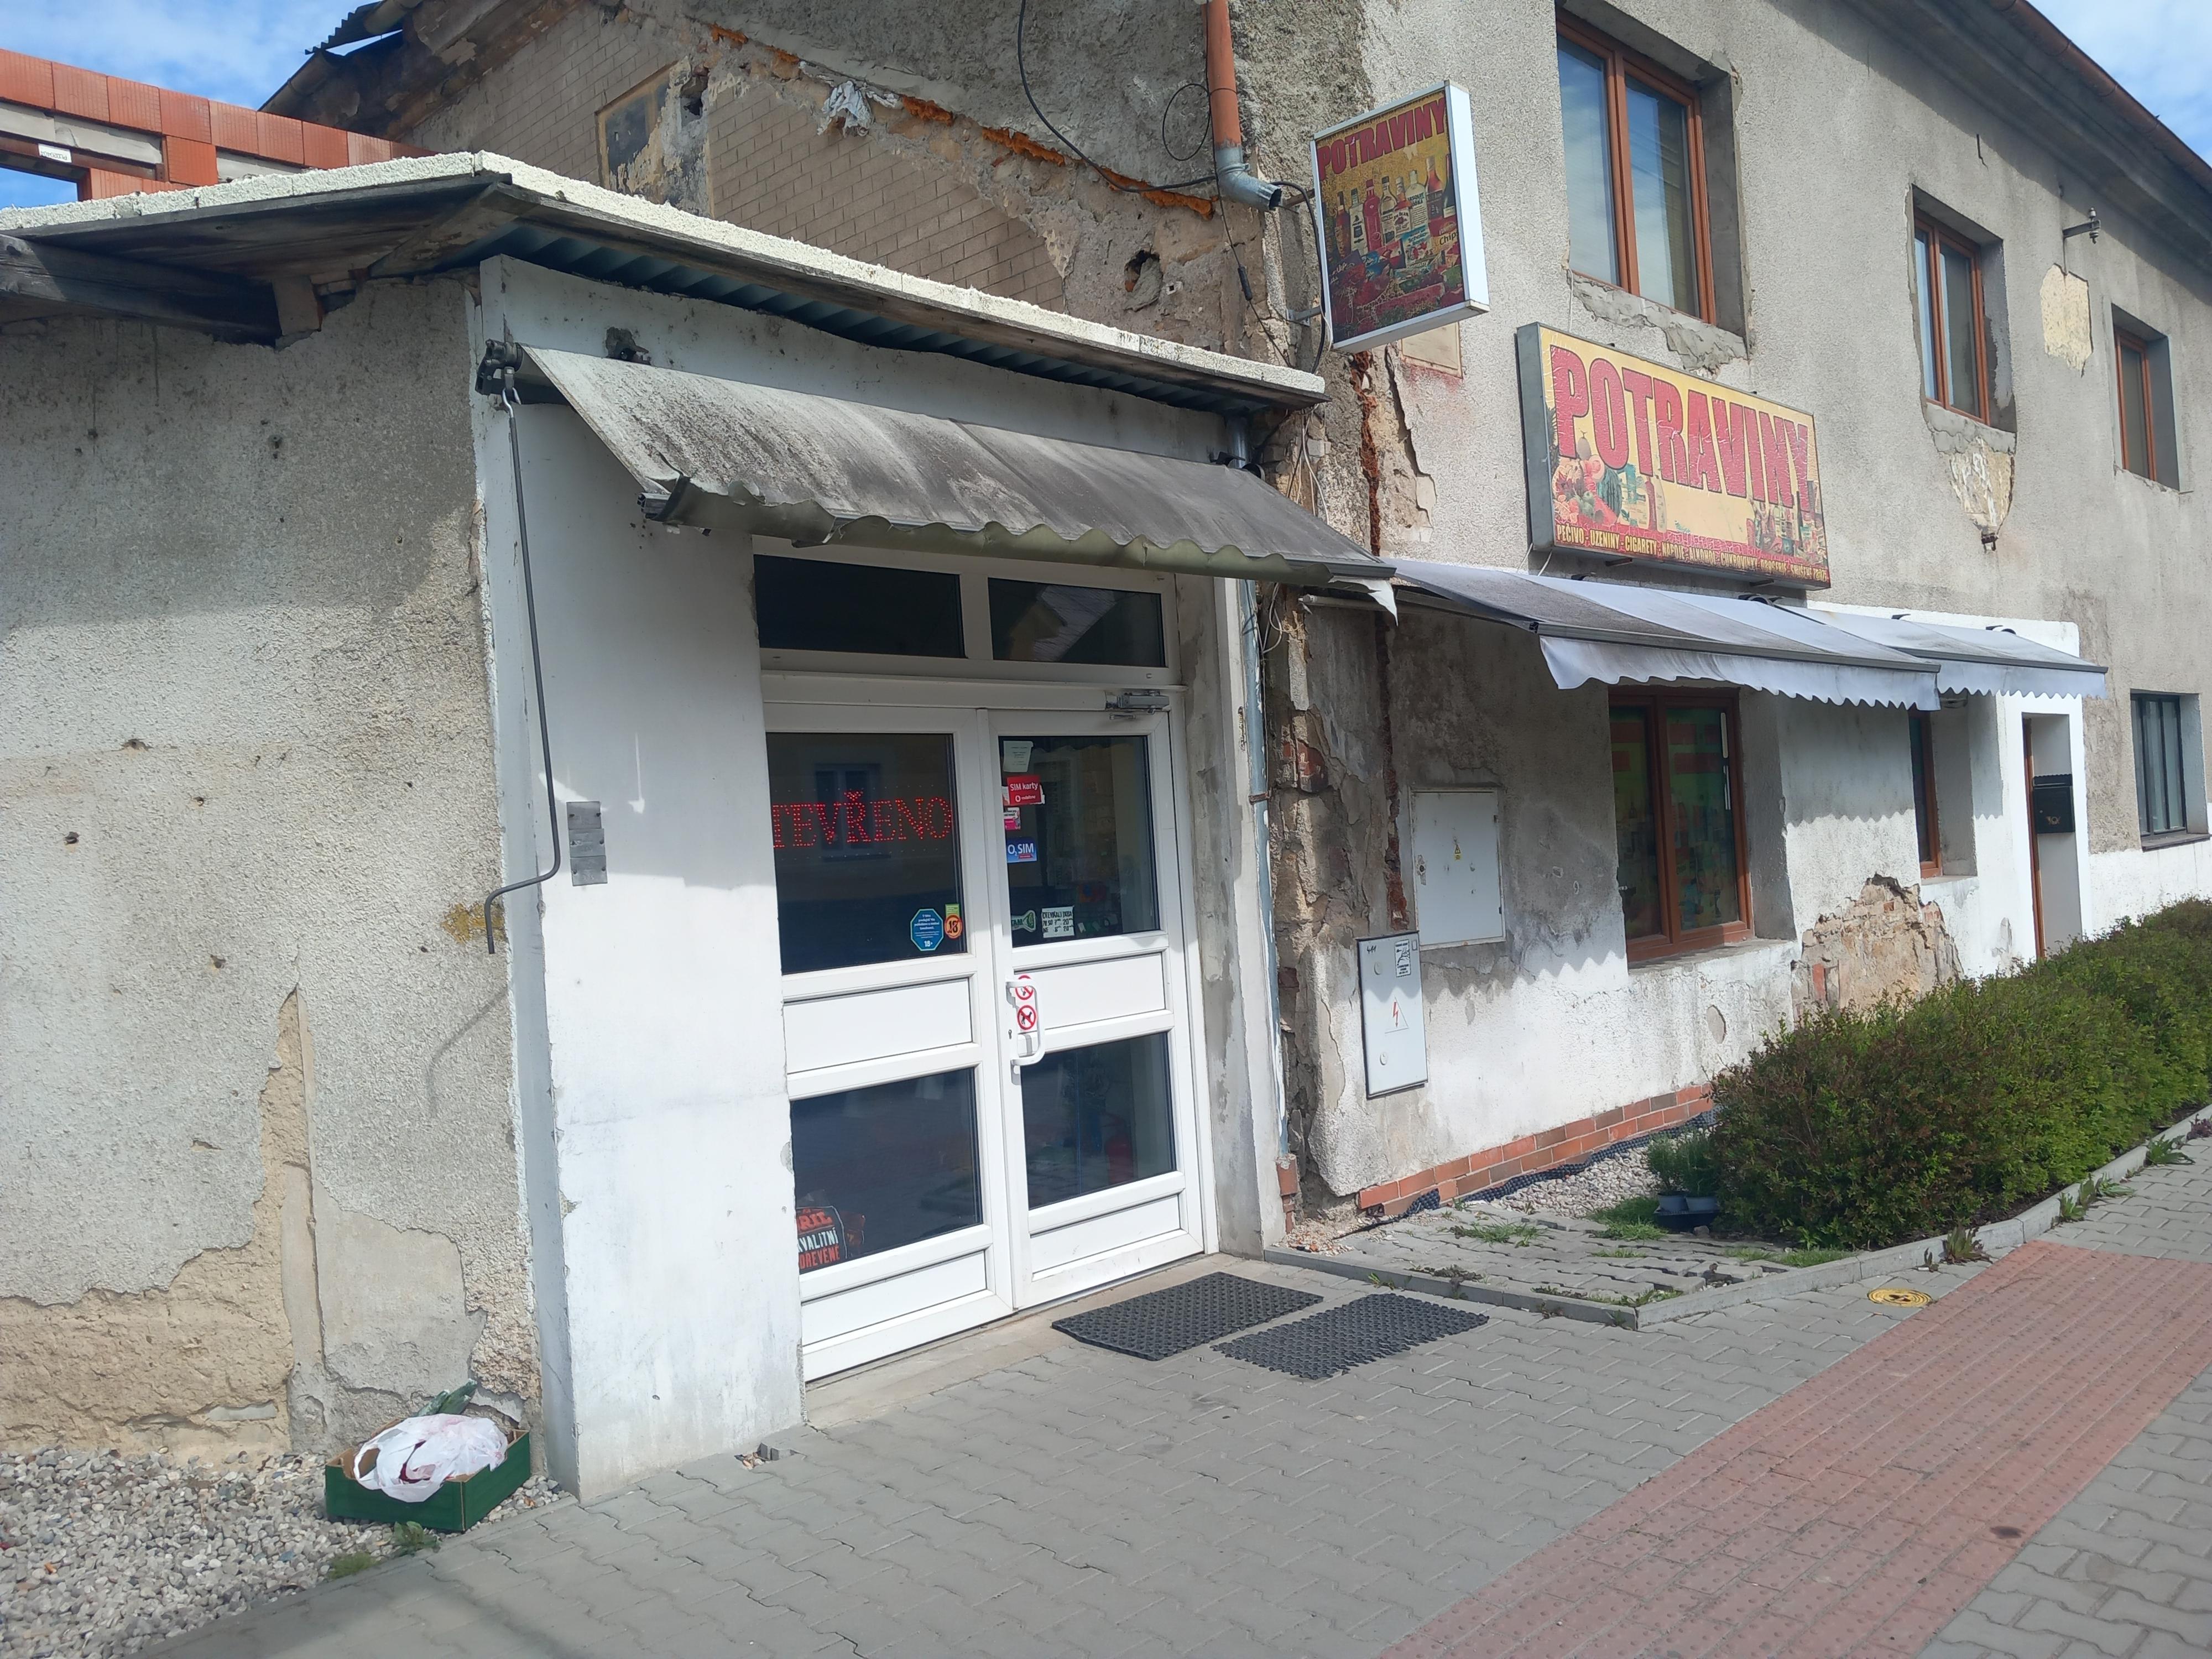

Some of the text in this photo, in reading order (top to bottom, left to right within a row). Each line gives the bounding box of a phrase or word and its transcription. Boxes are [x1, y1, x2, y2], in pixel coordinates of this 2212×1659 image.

[1317, 97, 1447, 181] POTRAVINY
[1550, 345, 1810, 513] POTRAVINY
[1556, 523, 1585, 545] PEČIVO
[1589, 529, 1620, 550] UZENINY
[1625, 535, 1657, 555] CIGARETY
[1022, 782, 1038, 790] karty
[773, 790, 953, 848] TEVŘENO
[1018, 843, 1034, 854] SIM
[949, 920, 958, 933] 18
